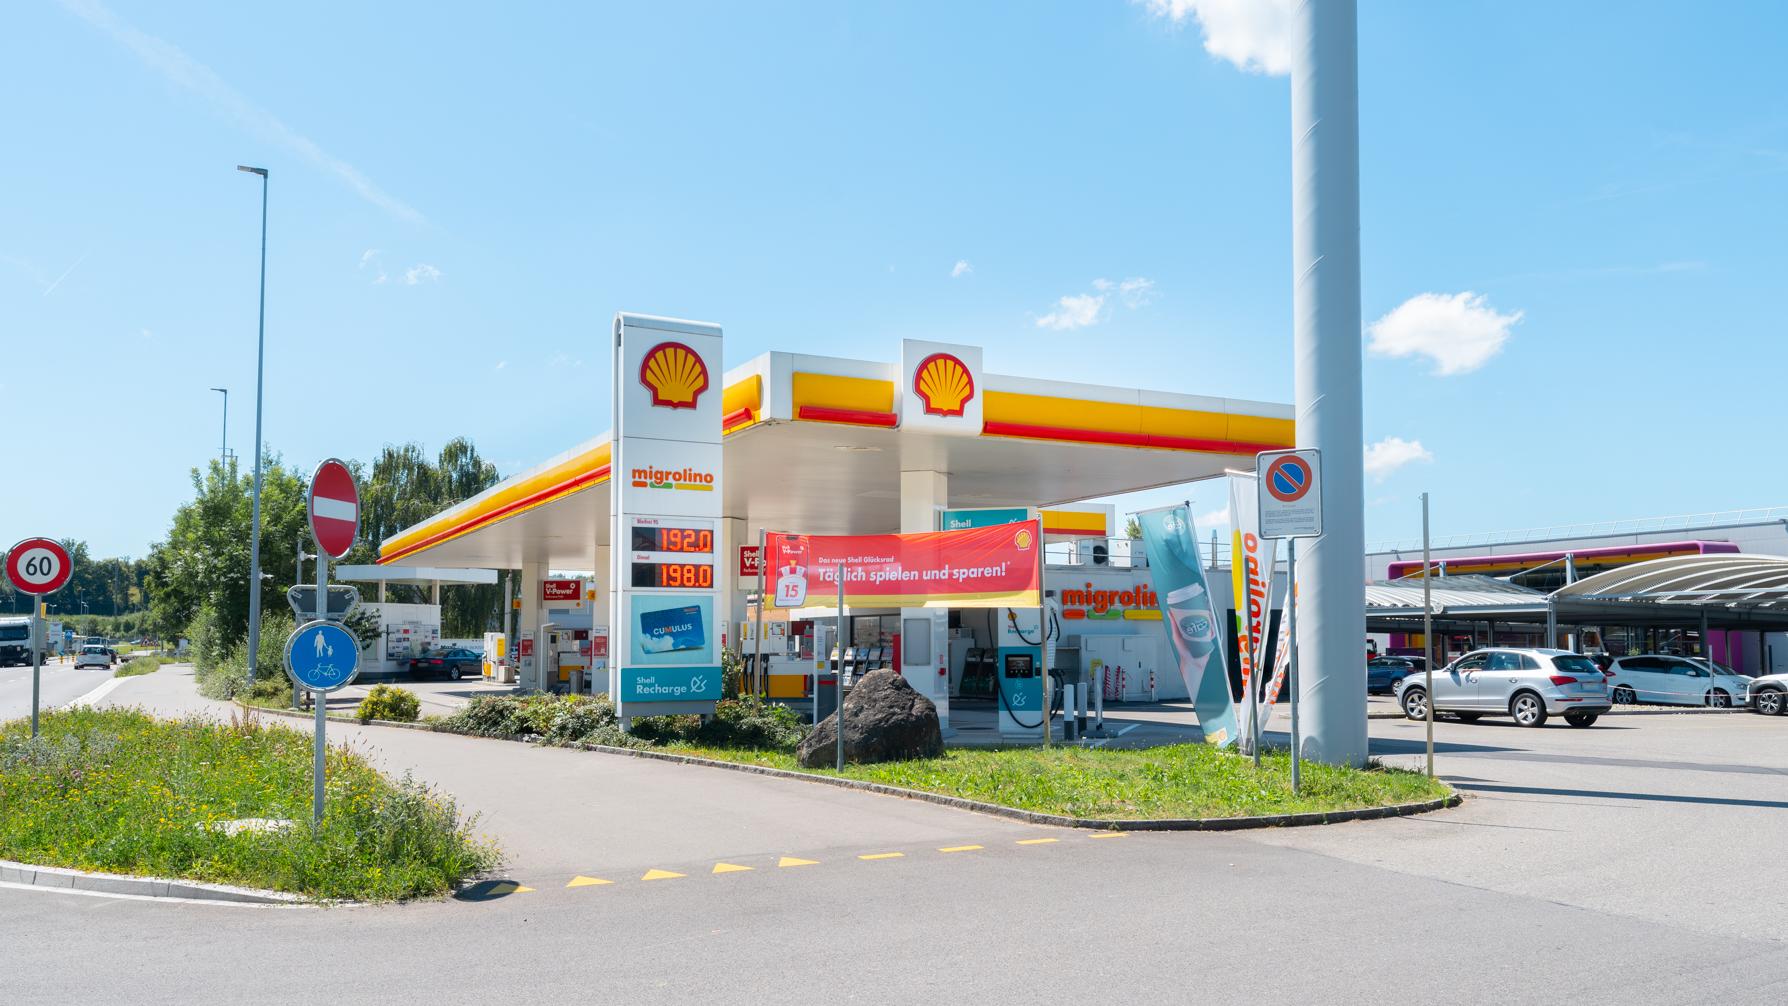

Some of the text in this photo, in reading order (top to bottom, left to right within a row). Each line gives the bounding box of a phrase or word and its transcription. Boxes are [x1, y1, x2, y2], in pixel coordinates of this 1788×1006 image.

[632, 466, 713, 485] migrolino
[950, 519, 971, 528] Shell
[661, 529, 711, 552] 192.0
[744, 550, 760, 558] Shell
[25, 556, 52, 577] 60
[661, 564, 711, 587] 198.0
[818, 567, 866, 585] Täglich
[869, 564, 918, 585] spielen
[922, 564, 949, 580] und
[785, 583, 799, 598] 15
[653, 623, 692, 635] CUMULUS
[636, 676, 655, 684] Shell
[636, 682, 687, 696] Recharge
